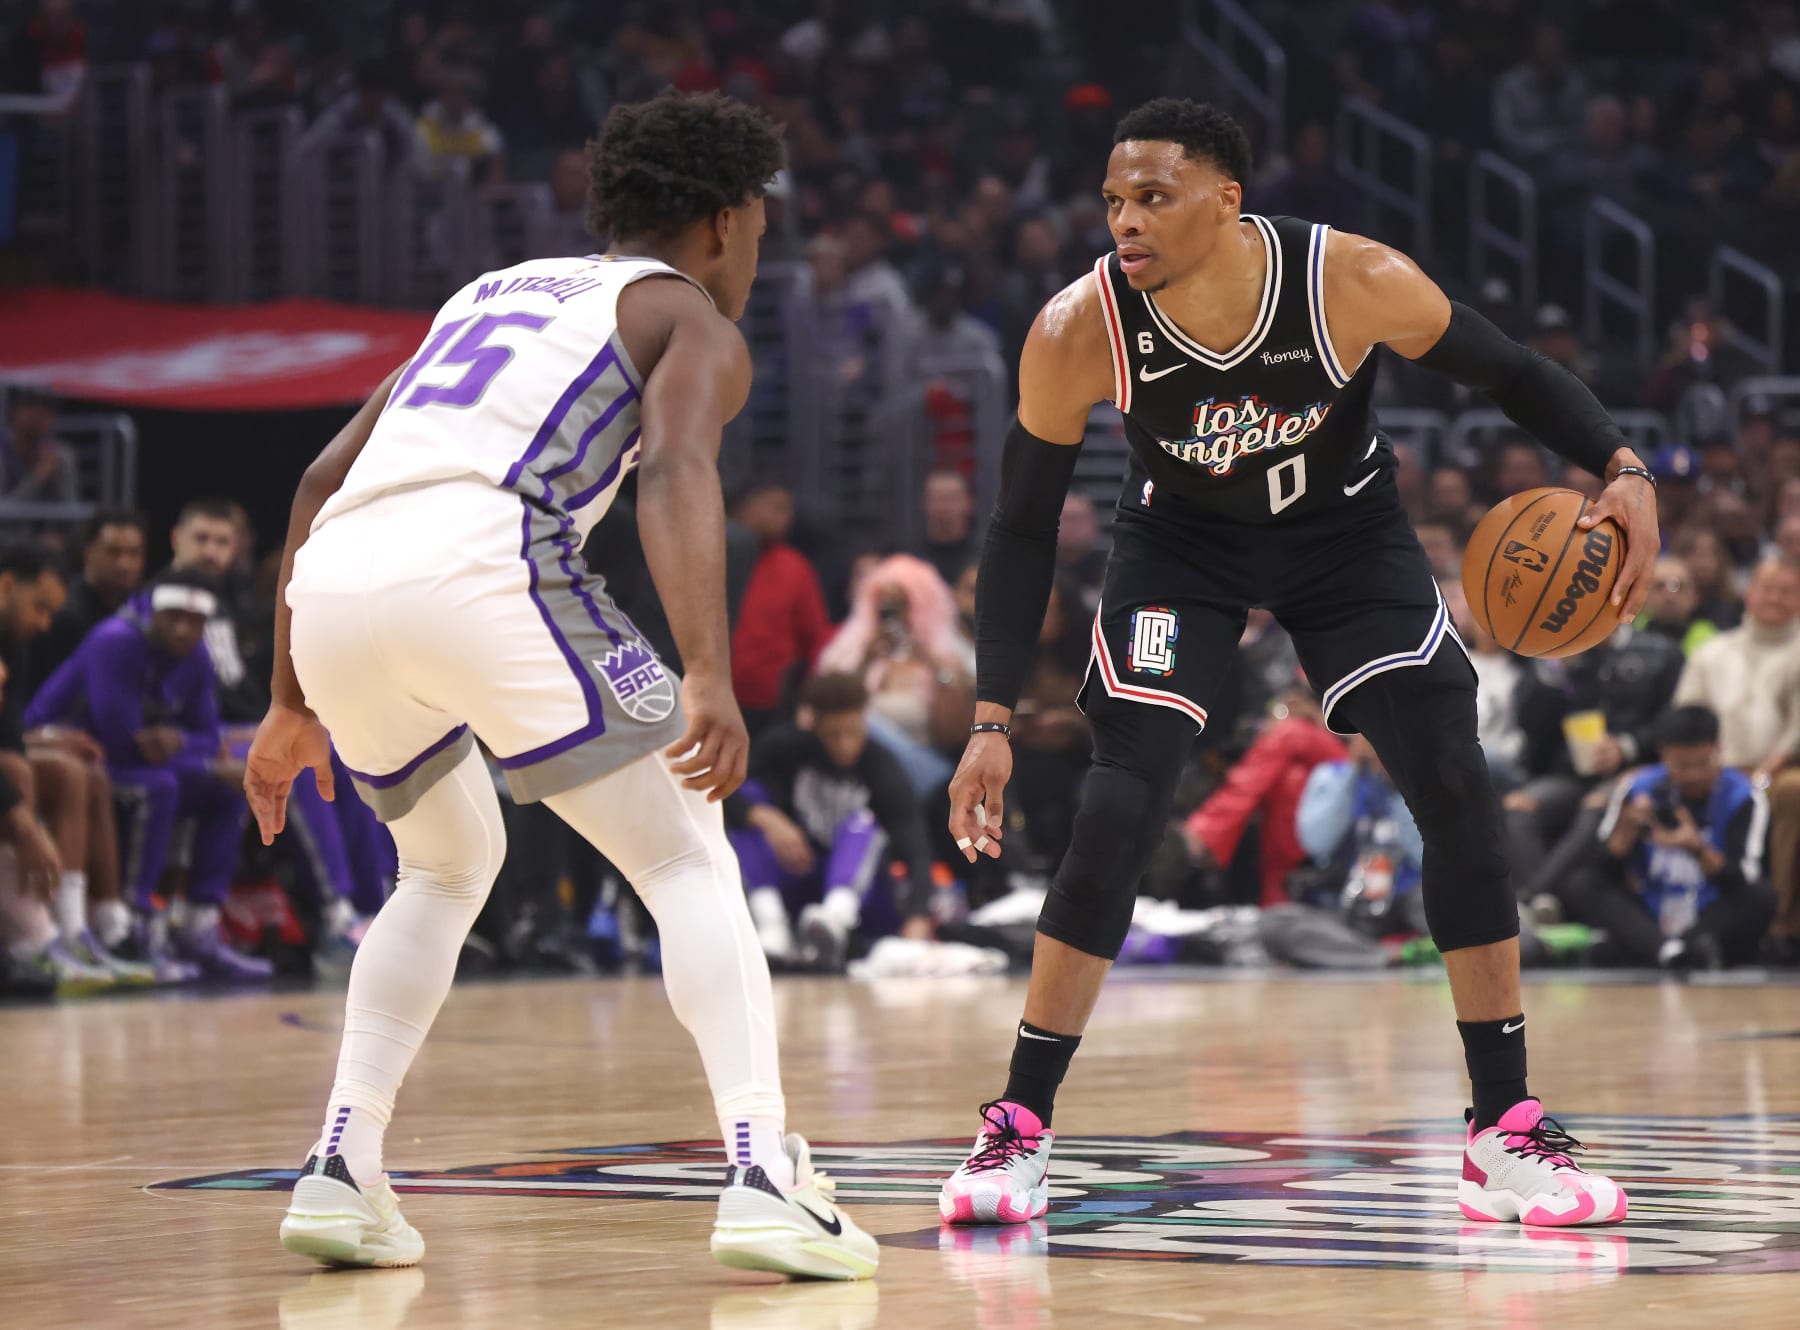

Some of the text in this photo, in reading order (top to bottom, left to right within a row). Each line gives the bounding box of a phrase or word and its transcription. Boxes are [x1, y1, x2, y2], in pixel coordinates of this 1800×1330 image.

[383, 311, 557, 411] 15
[1137, 331, 1155, 354] 6
[1260, 347, 1313, 366] honey
[1266, 453, 1307, 515] 0
[1540, 529, 1613, 634] Wilson
[613, 662, 664, 701] SAC
